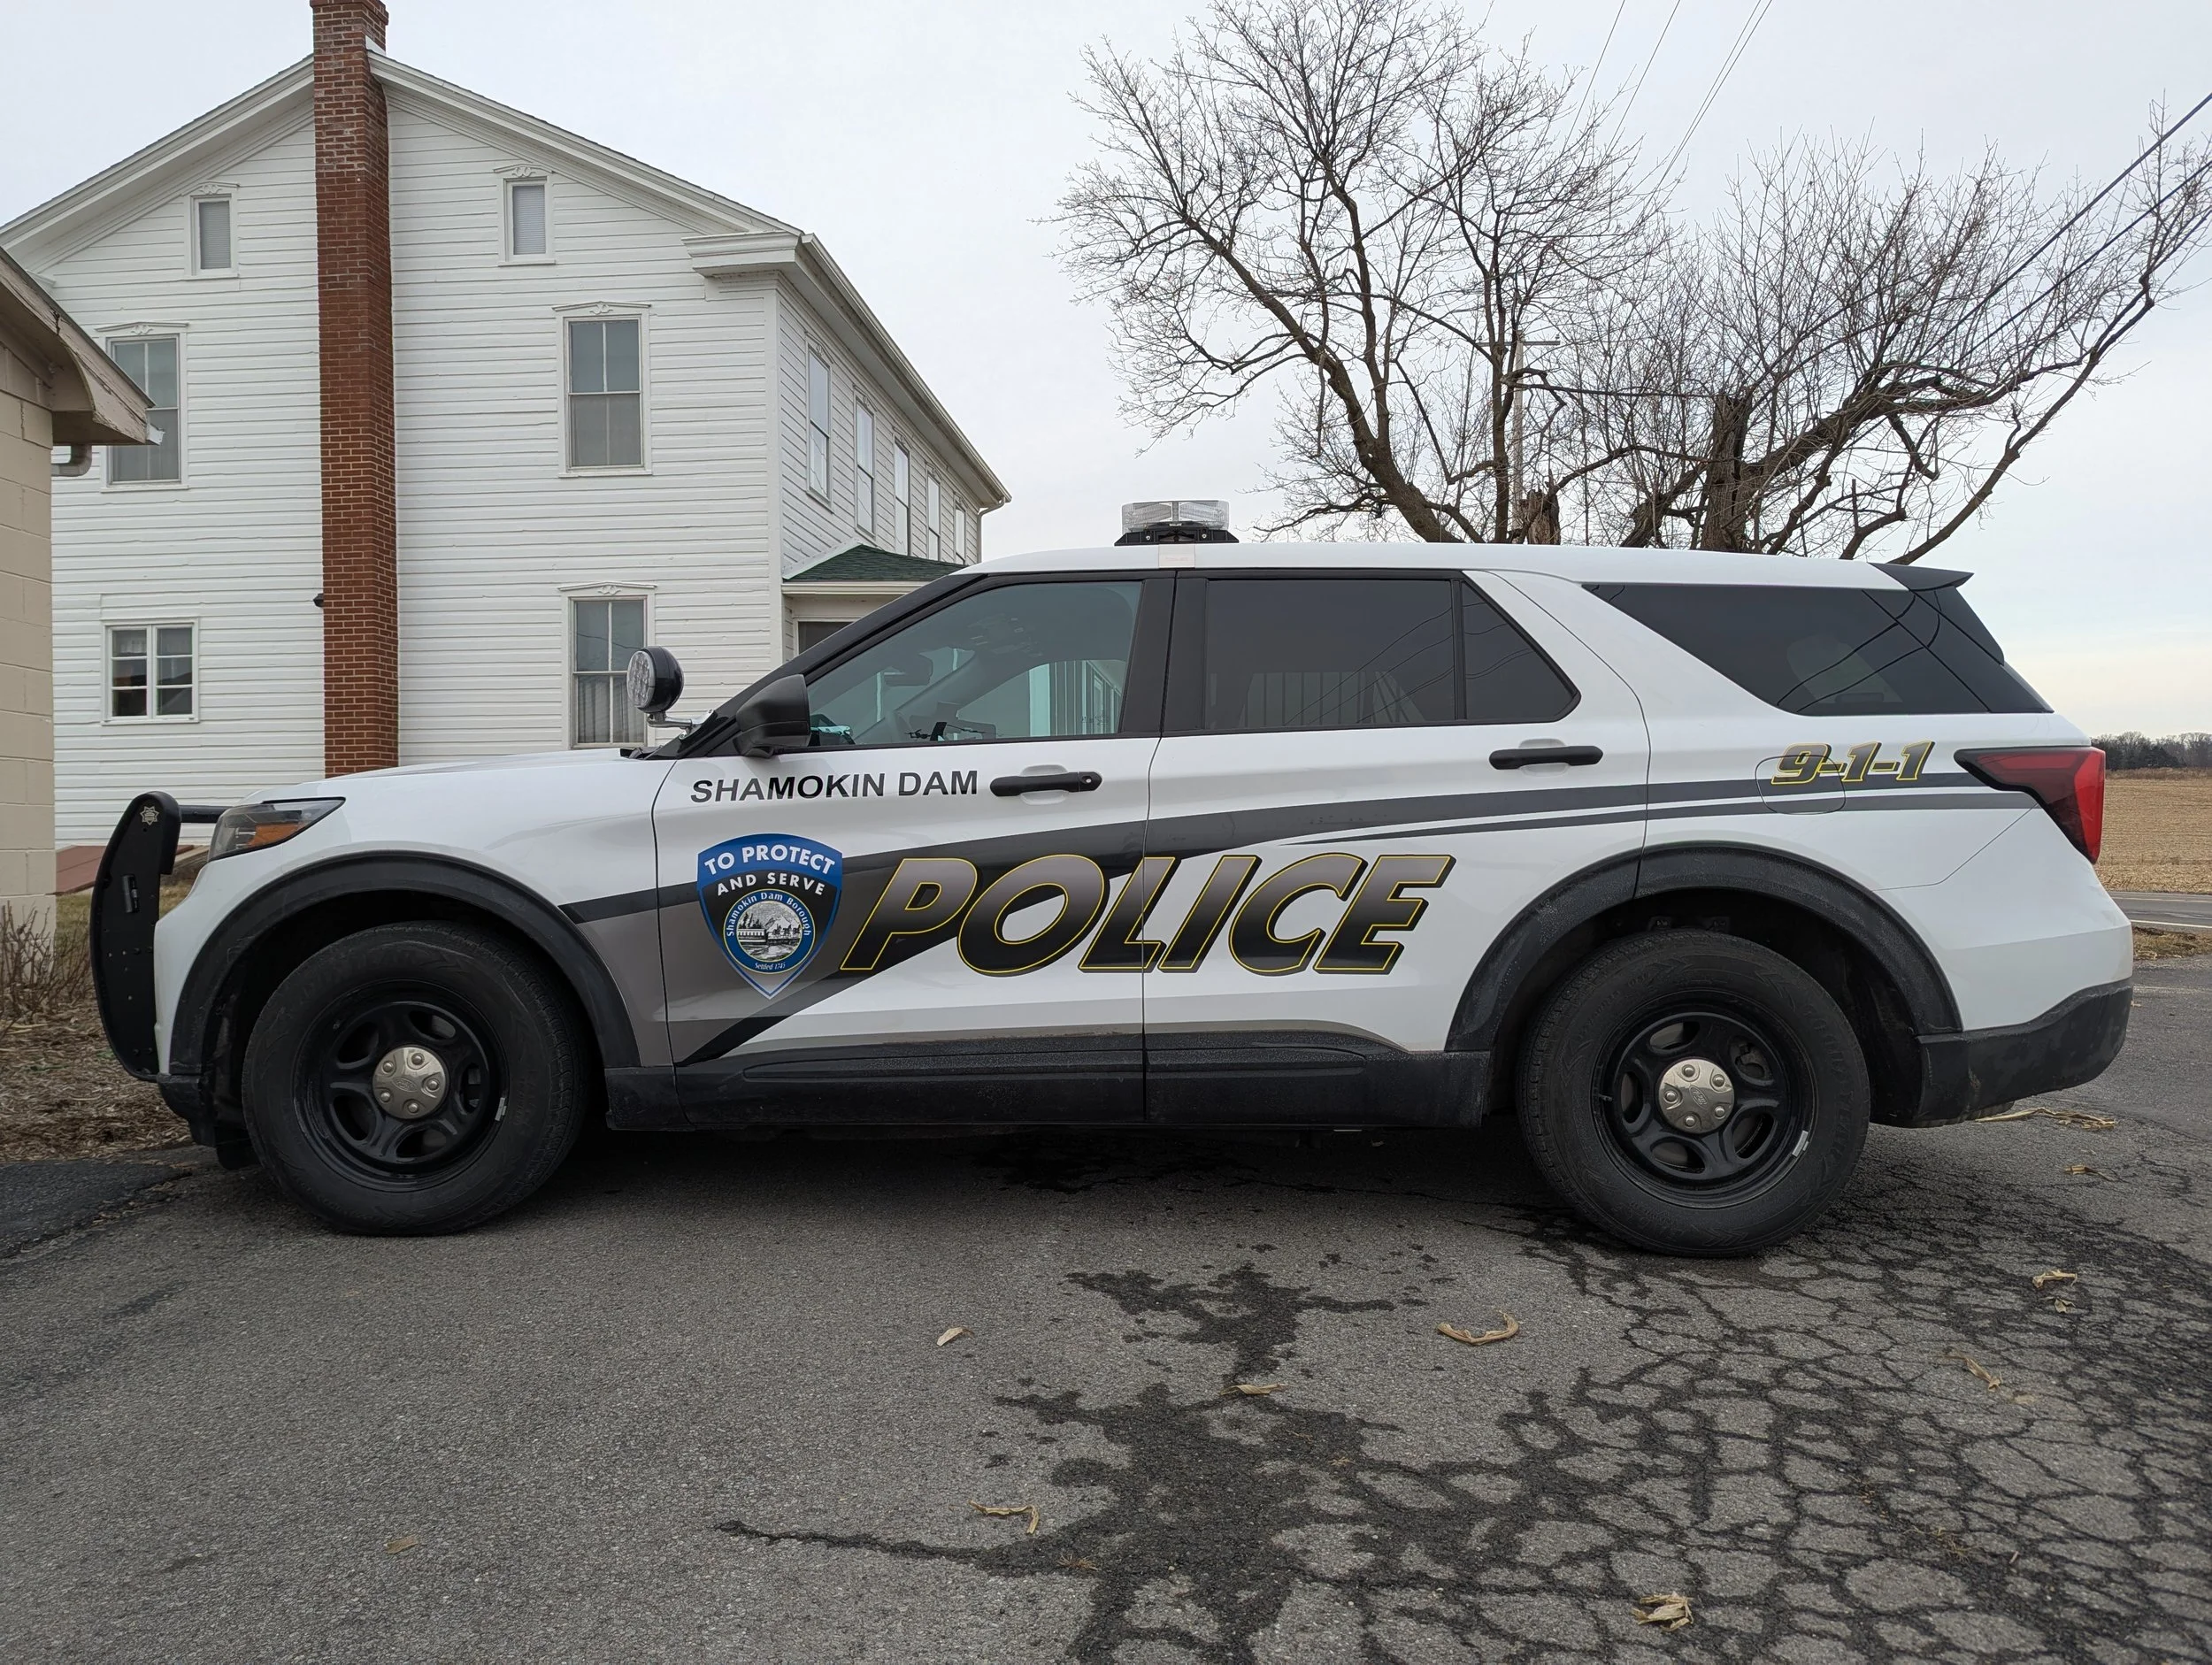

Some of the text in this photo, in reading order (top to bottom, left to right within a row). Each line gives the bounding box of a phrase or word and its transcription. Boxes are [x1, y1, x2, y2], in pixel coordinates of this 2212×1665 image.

[1770, 741, 1935, 785] 9-1-1
[690, 770, 979, 803] SHAMOKIN DAM
[704, 844, 835, 875] TO PROTECT
[718, 872, 826, 896] AND SERVE
[726, 892, 811, 937] Shamokin Dam Borough
[840, 853, 1457, 978] POLICE
